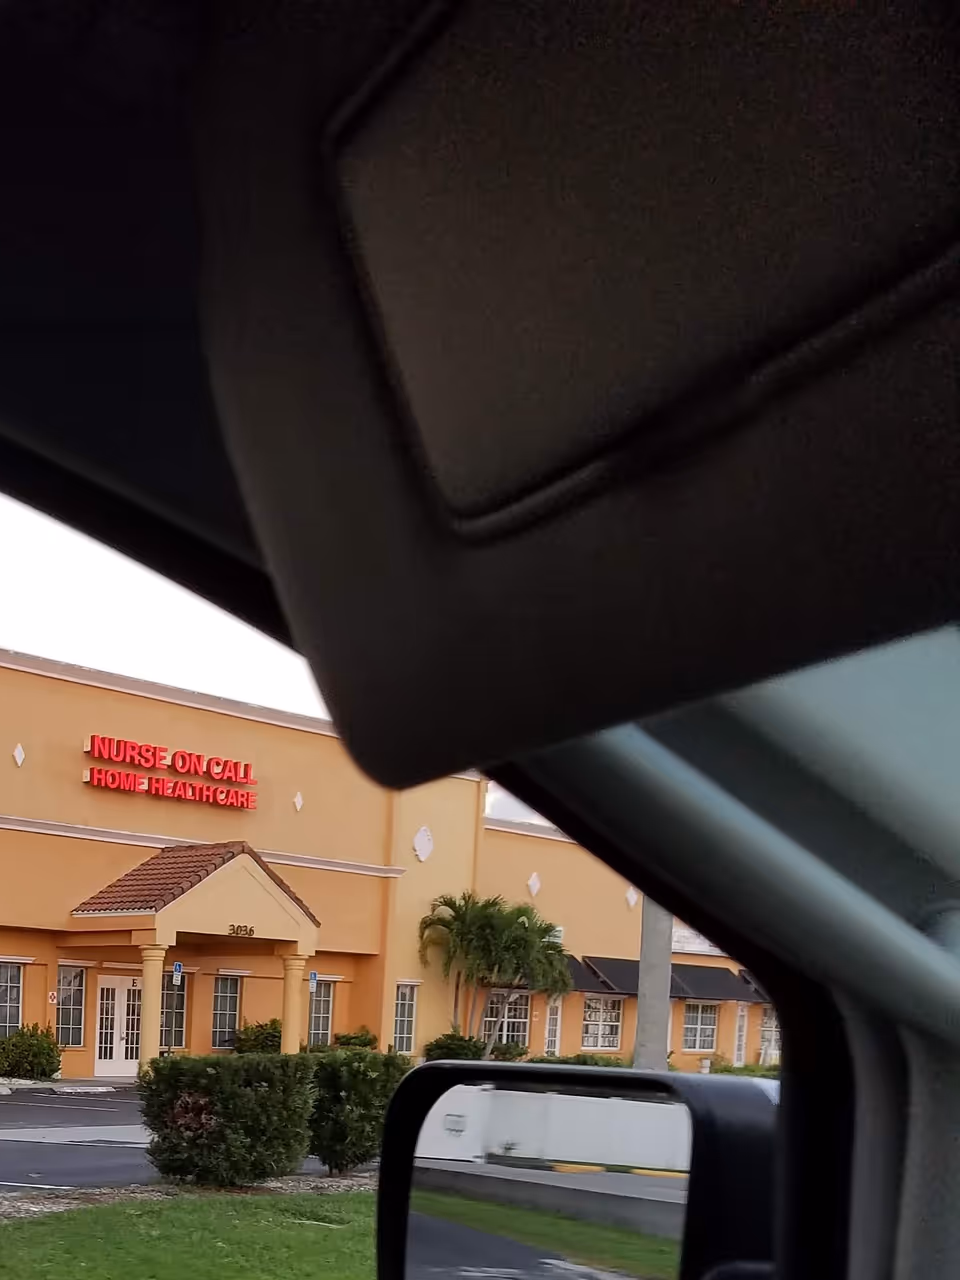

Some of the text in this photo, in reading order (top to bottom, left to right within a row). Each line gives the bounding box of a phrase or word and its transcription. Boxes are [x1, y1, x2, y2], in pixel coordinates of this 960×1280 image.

[91, 734, 258, 785] NURSE ON CALL
[90, 767, 258, 810] HOME HEALTH CARE
[228, 924, 255, 936] 3036
[131, 978, 138, 987] E
